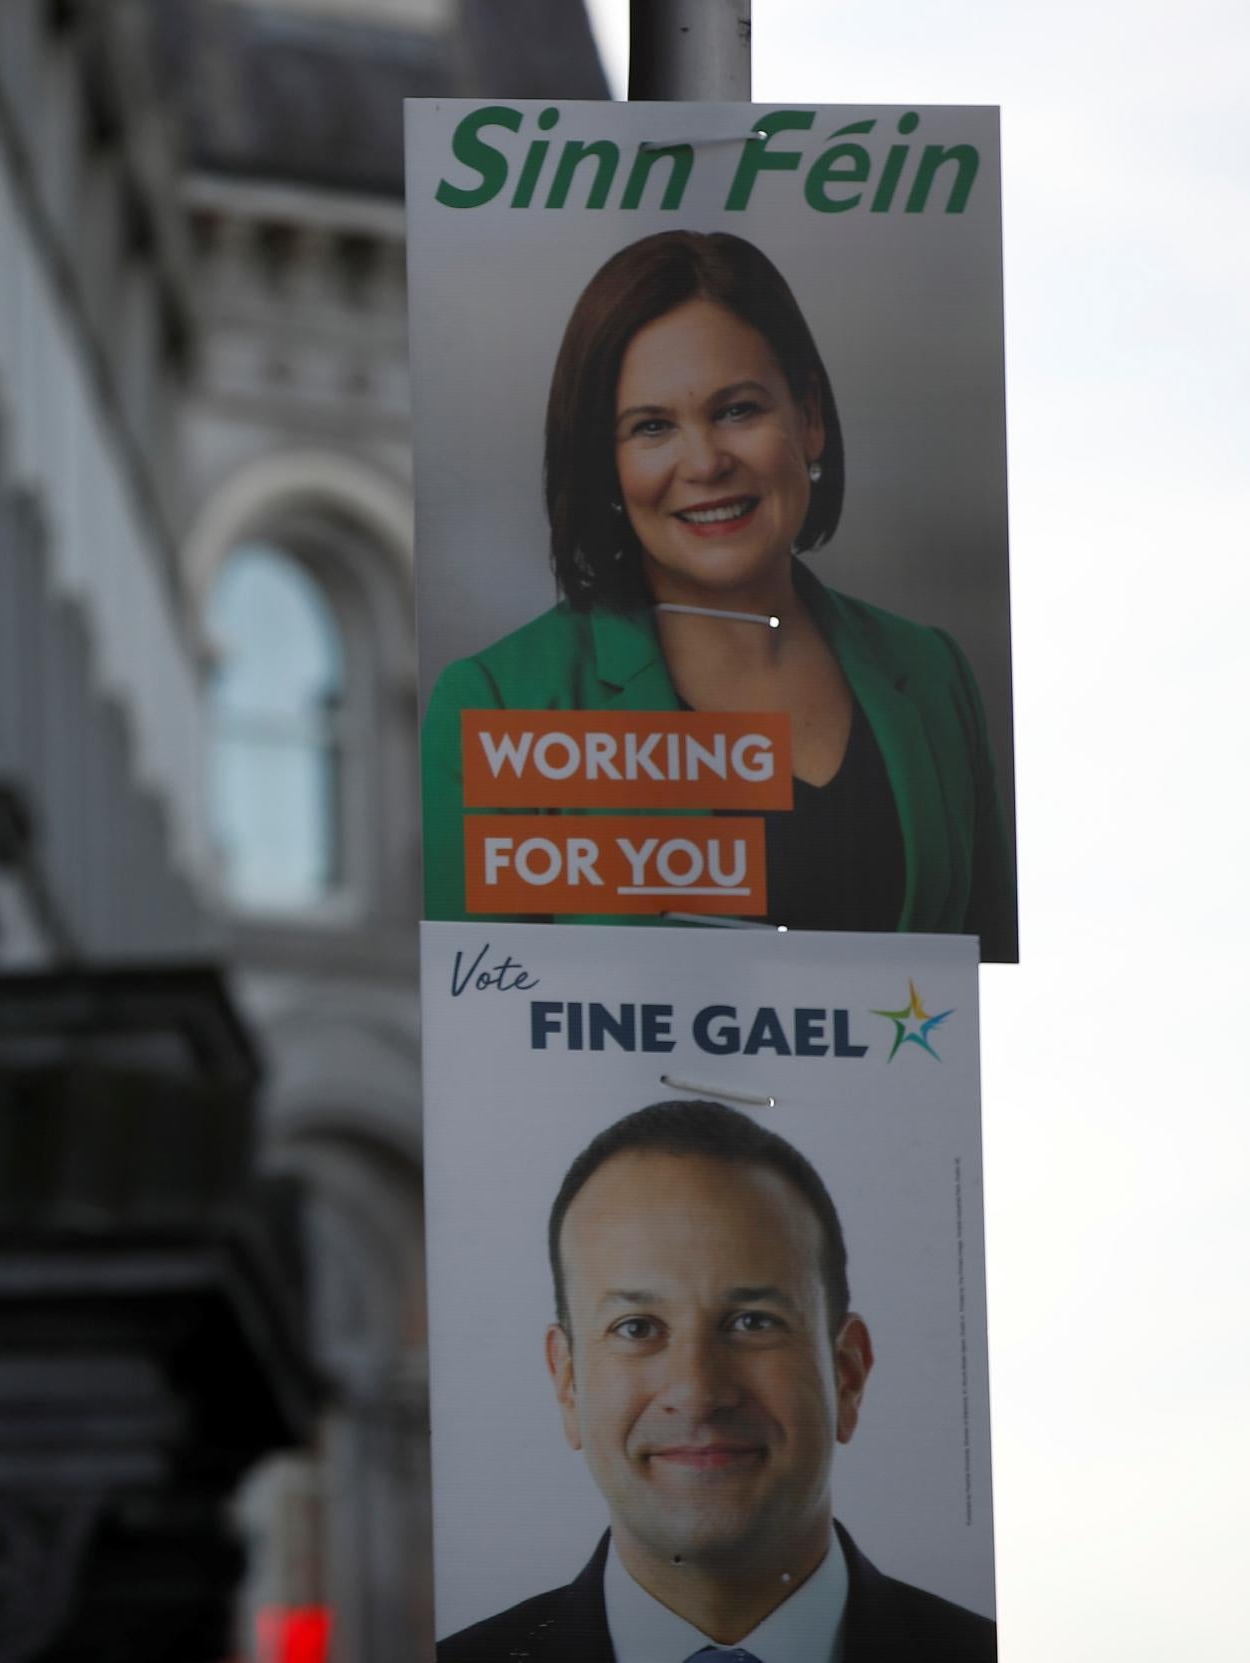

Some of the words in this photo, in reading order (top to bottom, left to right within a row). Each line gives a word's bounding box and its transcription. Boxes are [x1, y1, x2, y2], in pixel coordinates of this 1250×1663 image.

[435, 106, 694, 209] Sinn
[724, 110, 980, 213] Féin
[478, 732, 775, 782] WORKING
[484, 838, 604, 885] FOR
[616, 839, 748, 888] YOU
[450, 944, 540, 997] Vote
[530, 1001, 676, 1052] FINE
[692, 1005, 868, 1058] GAEL
